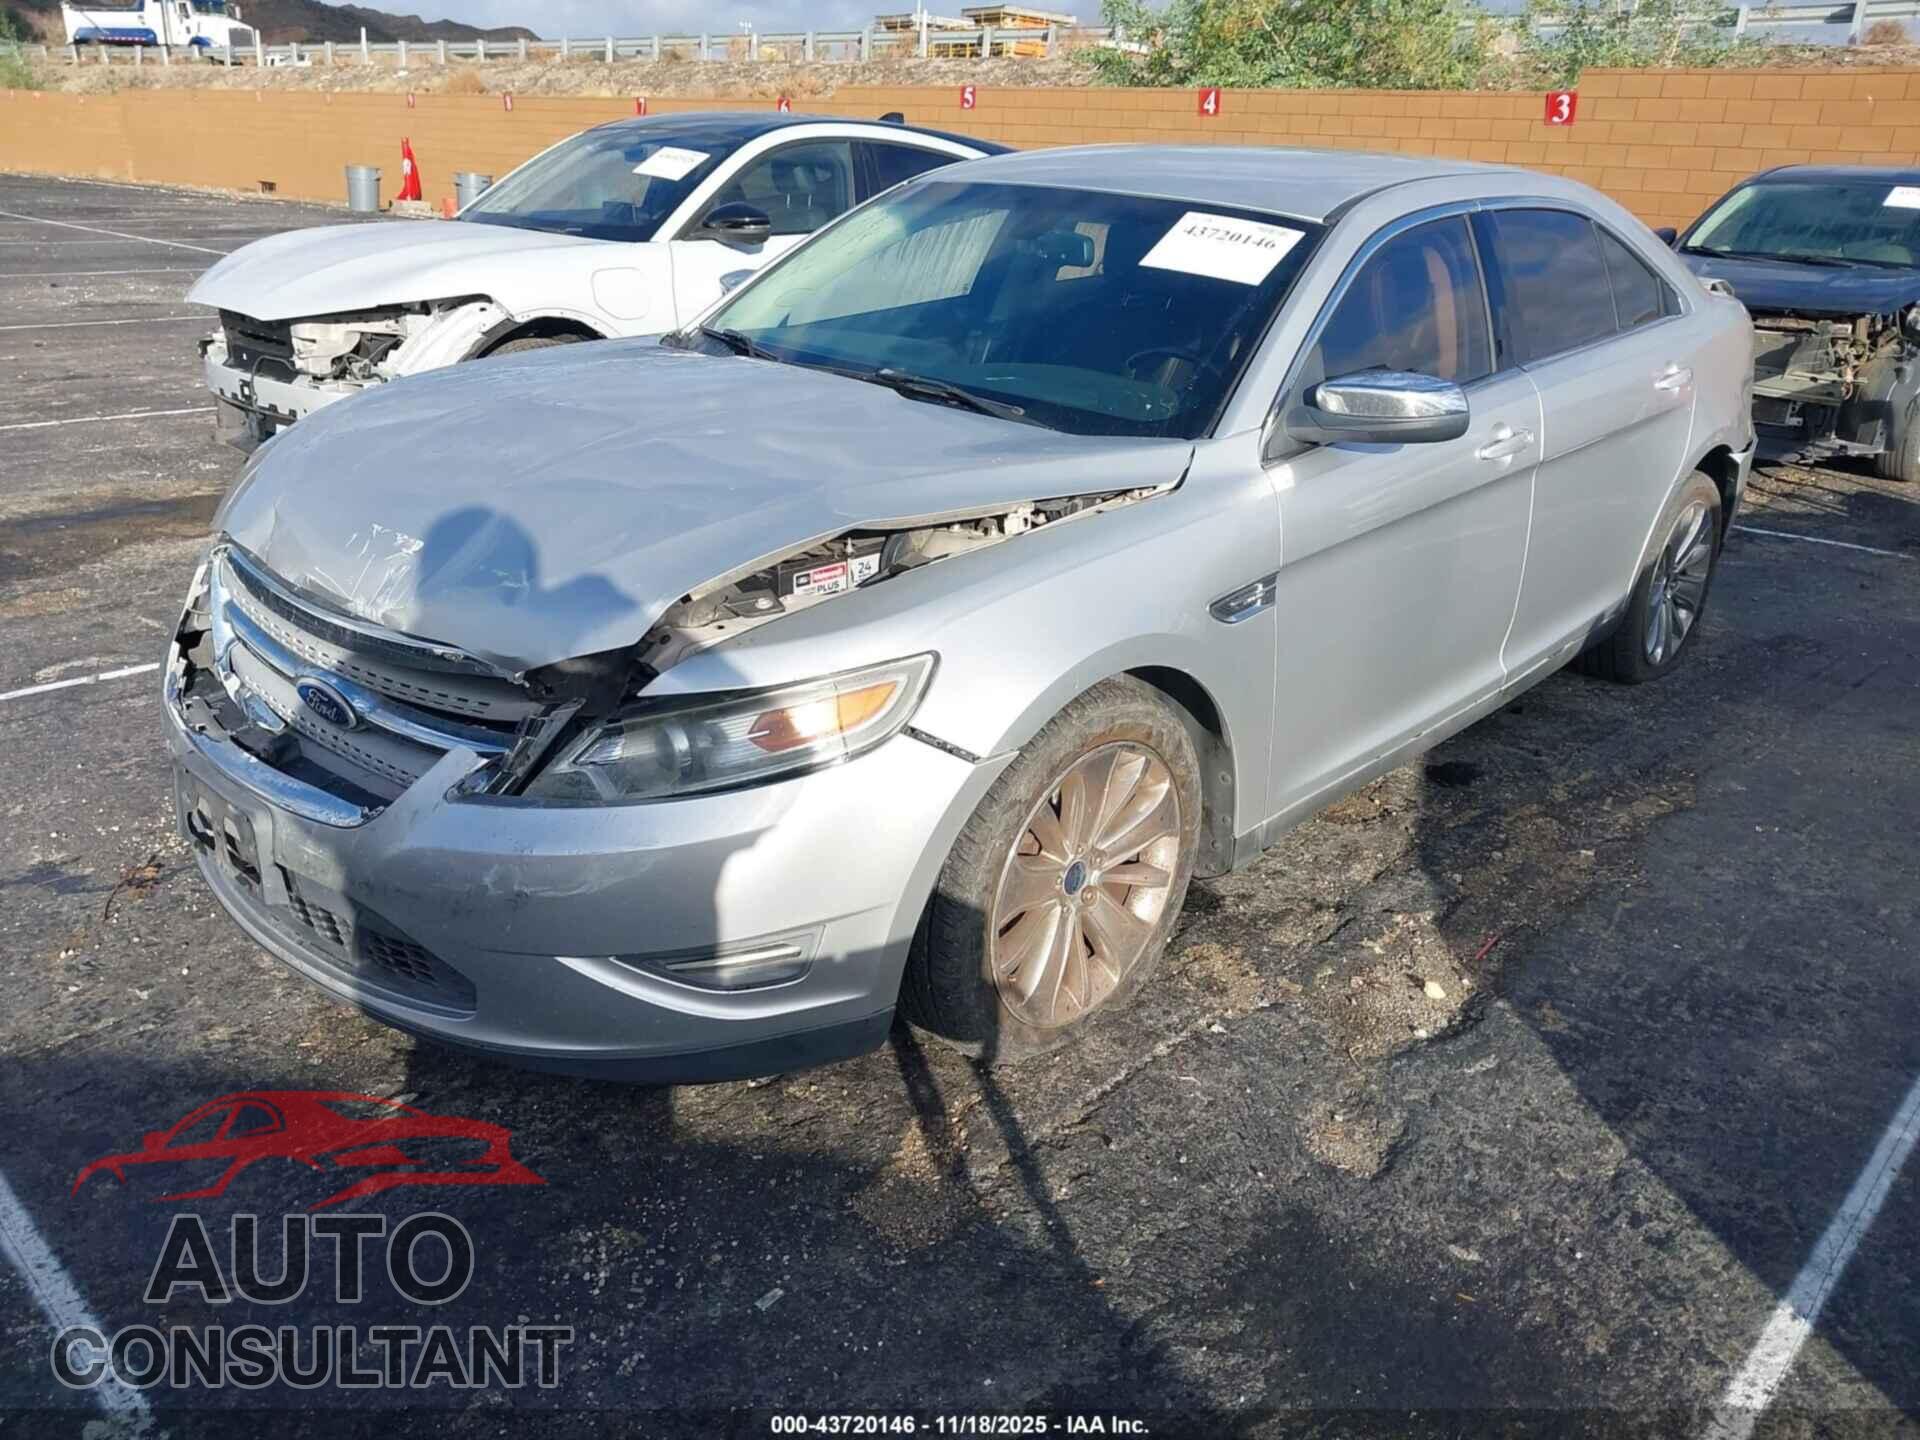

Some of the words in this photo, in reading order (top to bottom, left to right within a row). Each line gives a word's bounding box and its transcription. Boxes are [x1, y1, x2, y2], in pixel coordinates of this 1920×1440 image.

[963, 86, 974, 109] 5
[1203, 90, 1217, 115] 4
[1551, 94, 1571, 123] 3
[1183, 224, 1277, 250] 43720146
[857, 561, 872, 574] 24
[817, 580, 840, 592] PLUS
